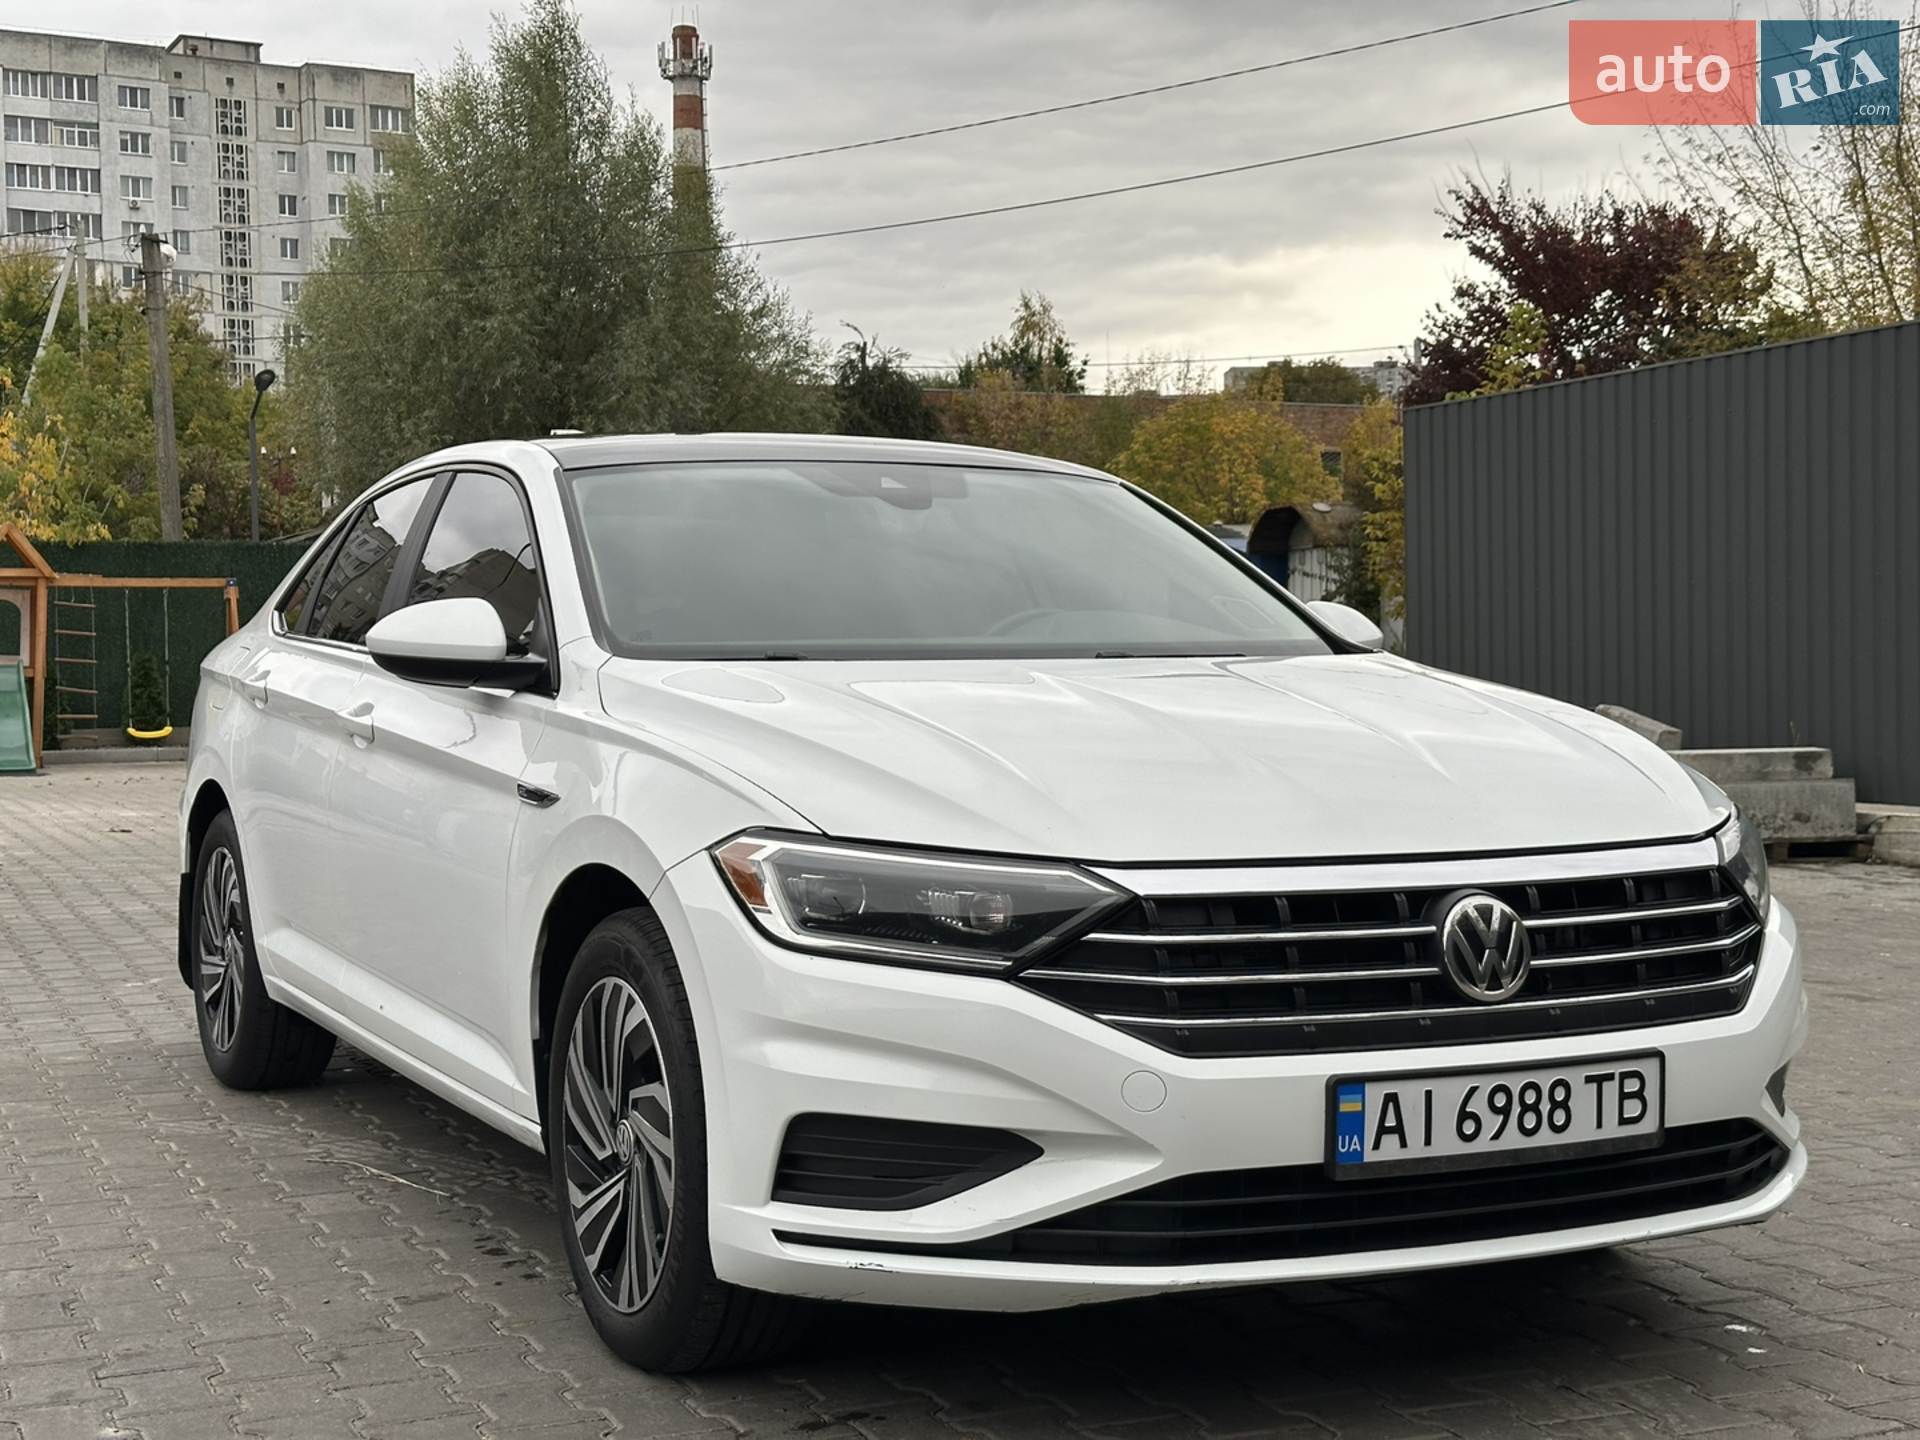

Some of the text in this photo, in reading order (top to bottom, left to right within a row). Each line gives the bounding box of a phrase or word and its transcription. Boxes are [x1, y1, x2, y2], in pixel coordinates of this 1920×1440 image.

[1370, 1069, 1648, 1151] AI 6988 TB
[1338, 1133, 1362, 1153] UA
